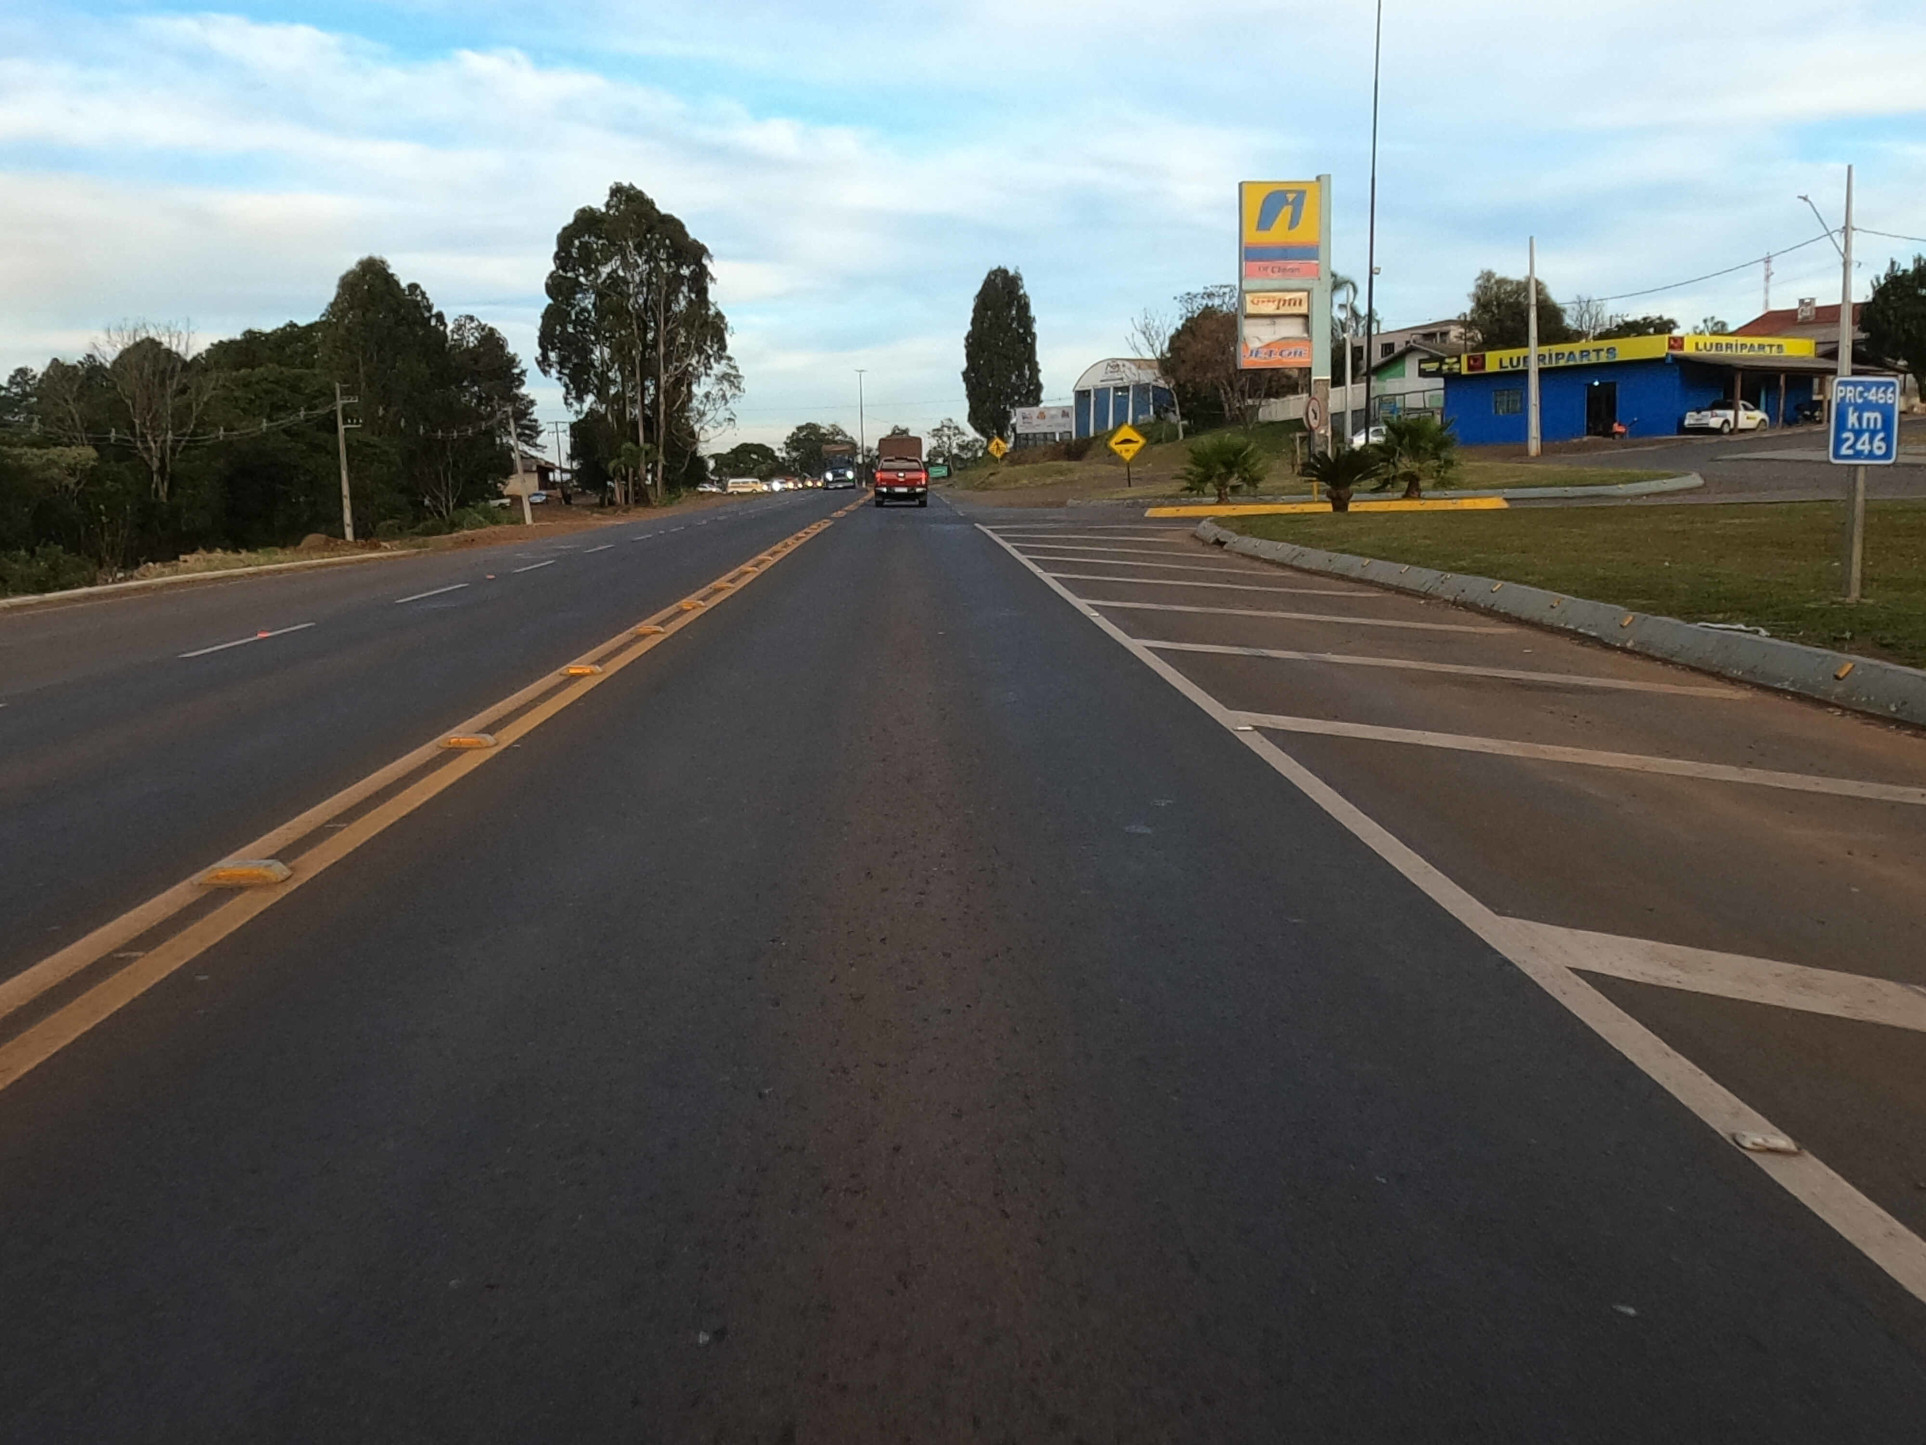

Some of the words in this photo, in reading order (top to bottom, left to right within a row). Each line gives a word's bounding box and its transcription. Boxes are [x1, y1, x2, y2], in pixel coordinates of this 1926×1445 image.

[1837, 385, 1895, 404] PRC-466
[1847, 407, 1883, 430] km
[1840, 432, 1887, 455] 246
